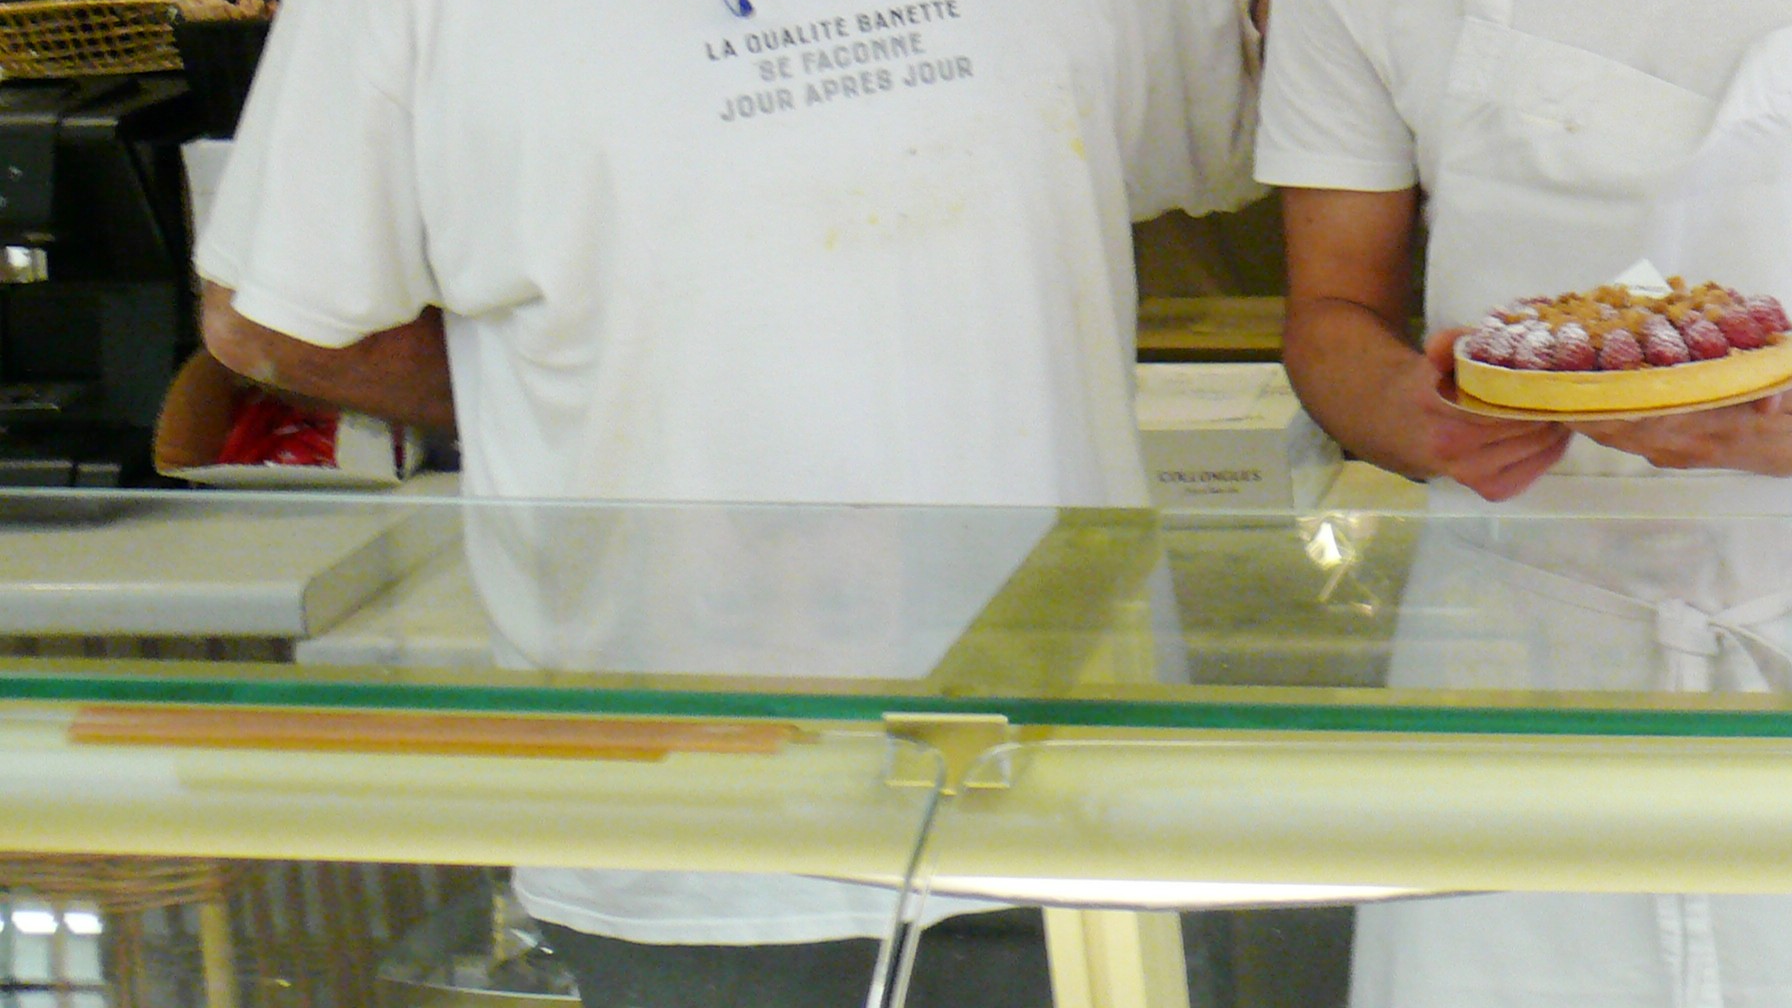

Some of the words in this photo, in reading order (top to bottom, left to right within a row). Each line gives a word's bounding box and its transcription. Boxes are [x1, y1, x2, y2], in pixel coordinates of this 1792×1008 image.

[704, 38, 738, 61] LA
[745, 16, 850, 53] QUALITE
[758, 55, 794, 82] SE
[801, 32, 926, 74] FACONNE
[719, 88, 796, 122] JOUR
[805, 67, 894, 107] APRES
[902, 55, 974, 88] JOUR
